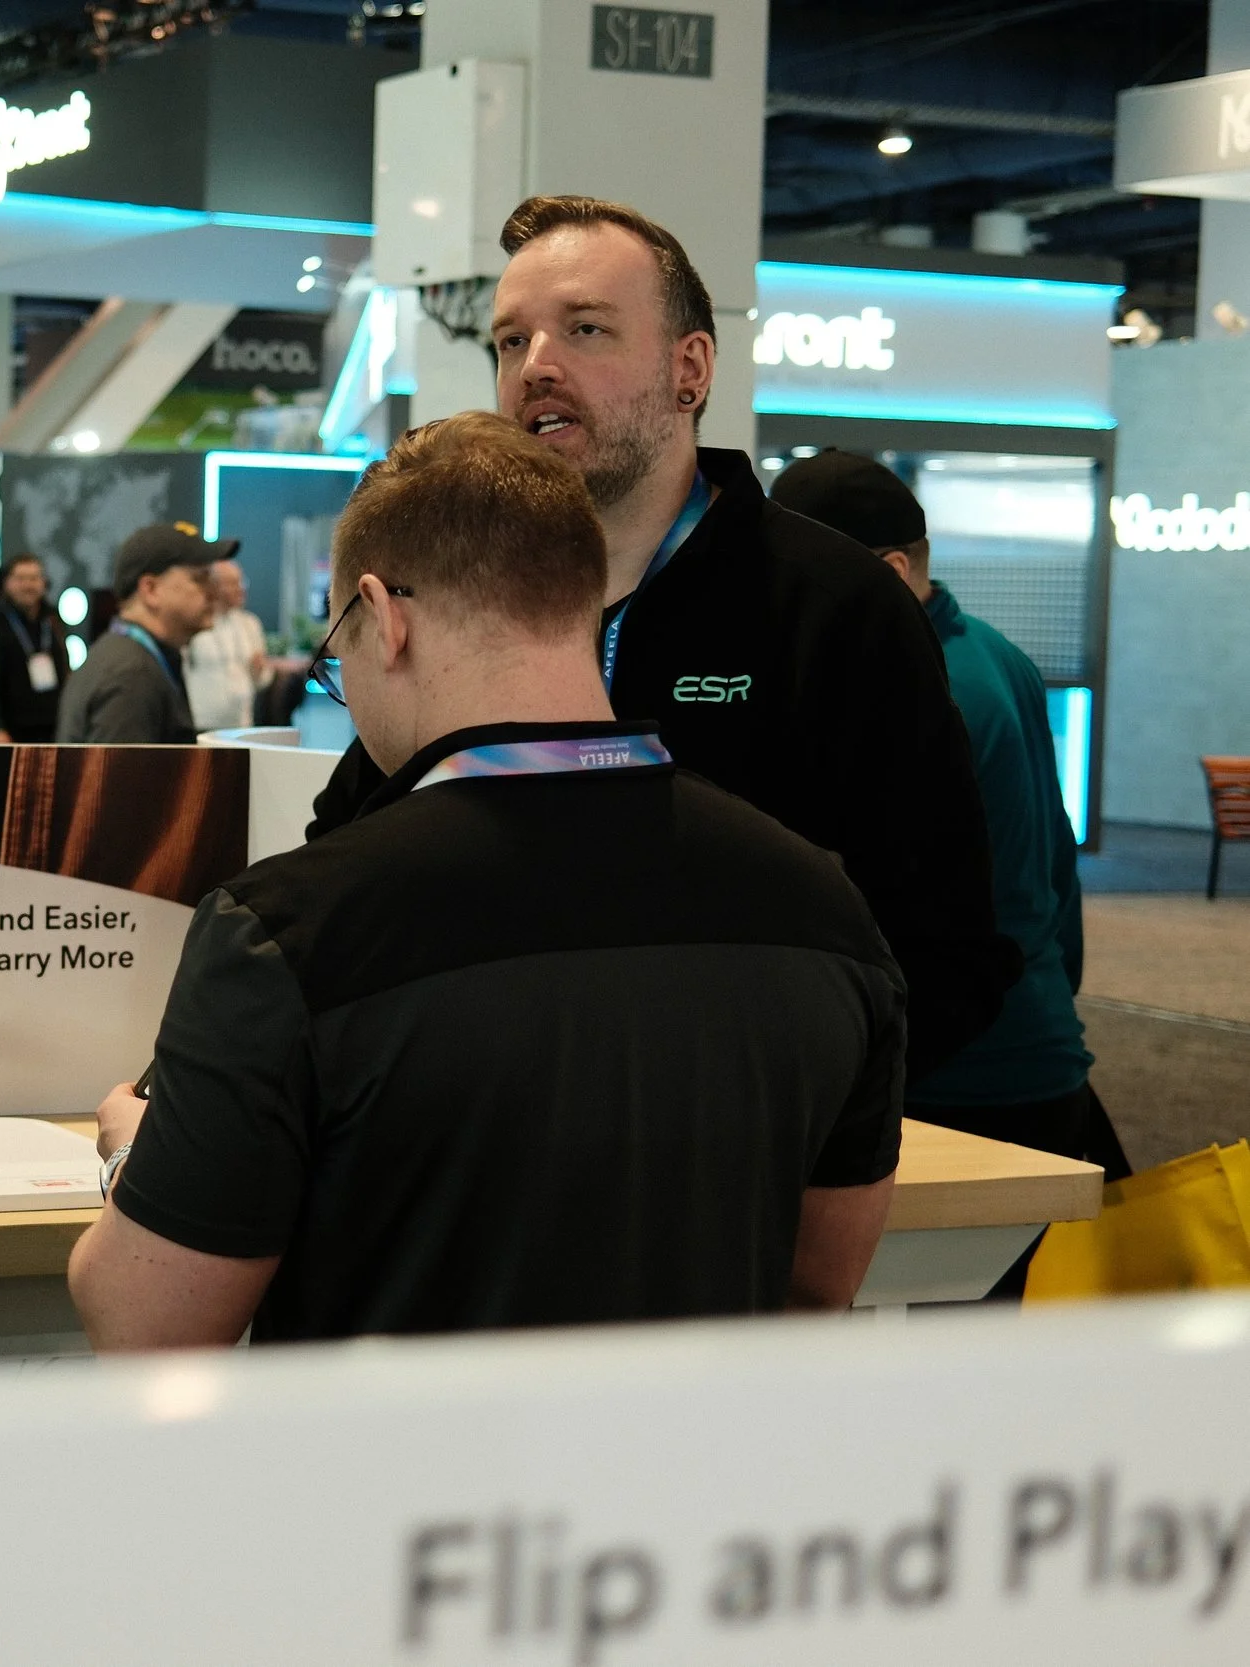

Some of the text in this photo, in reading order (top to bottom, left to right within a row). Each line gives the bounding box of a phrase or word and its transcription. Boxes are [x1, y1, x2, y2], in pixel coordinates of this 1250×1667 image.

[604, 621, 620, 678] AFEELA
[673, 674, 752, 702] ESR
[579, 751, 630, 767] AFEELA
[45, 904, 136, 932] Easier,
[61, 945, 134, 969] More
[401, 1465, 1250, 1667] Flip and Play
